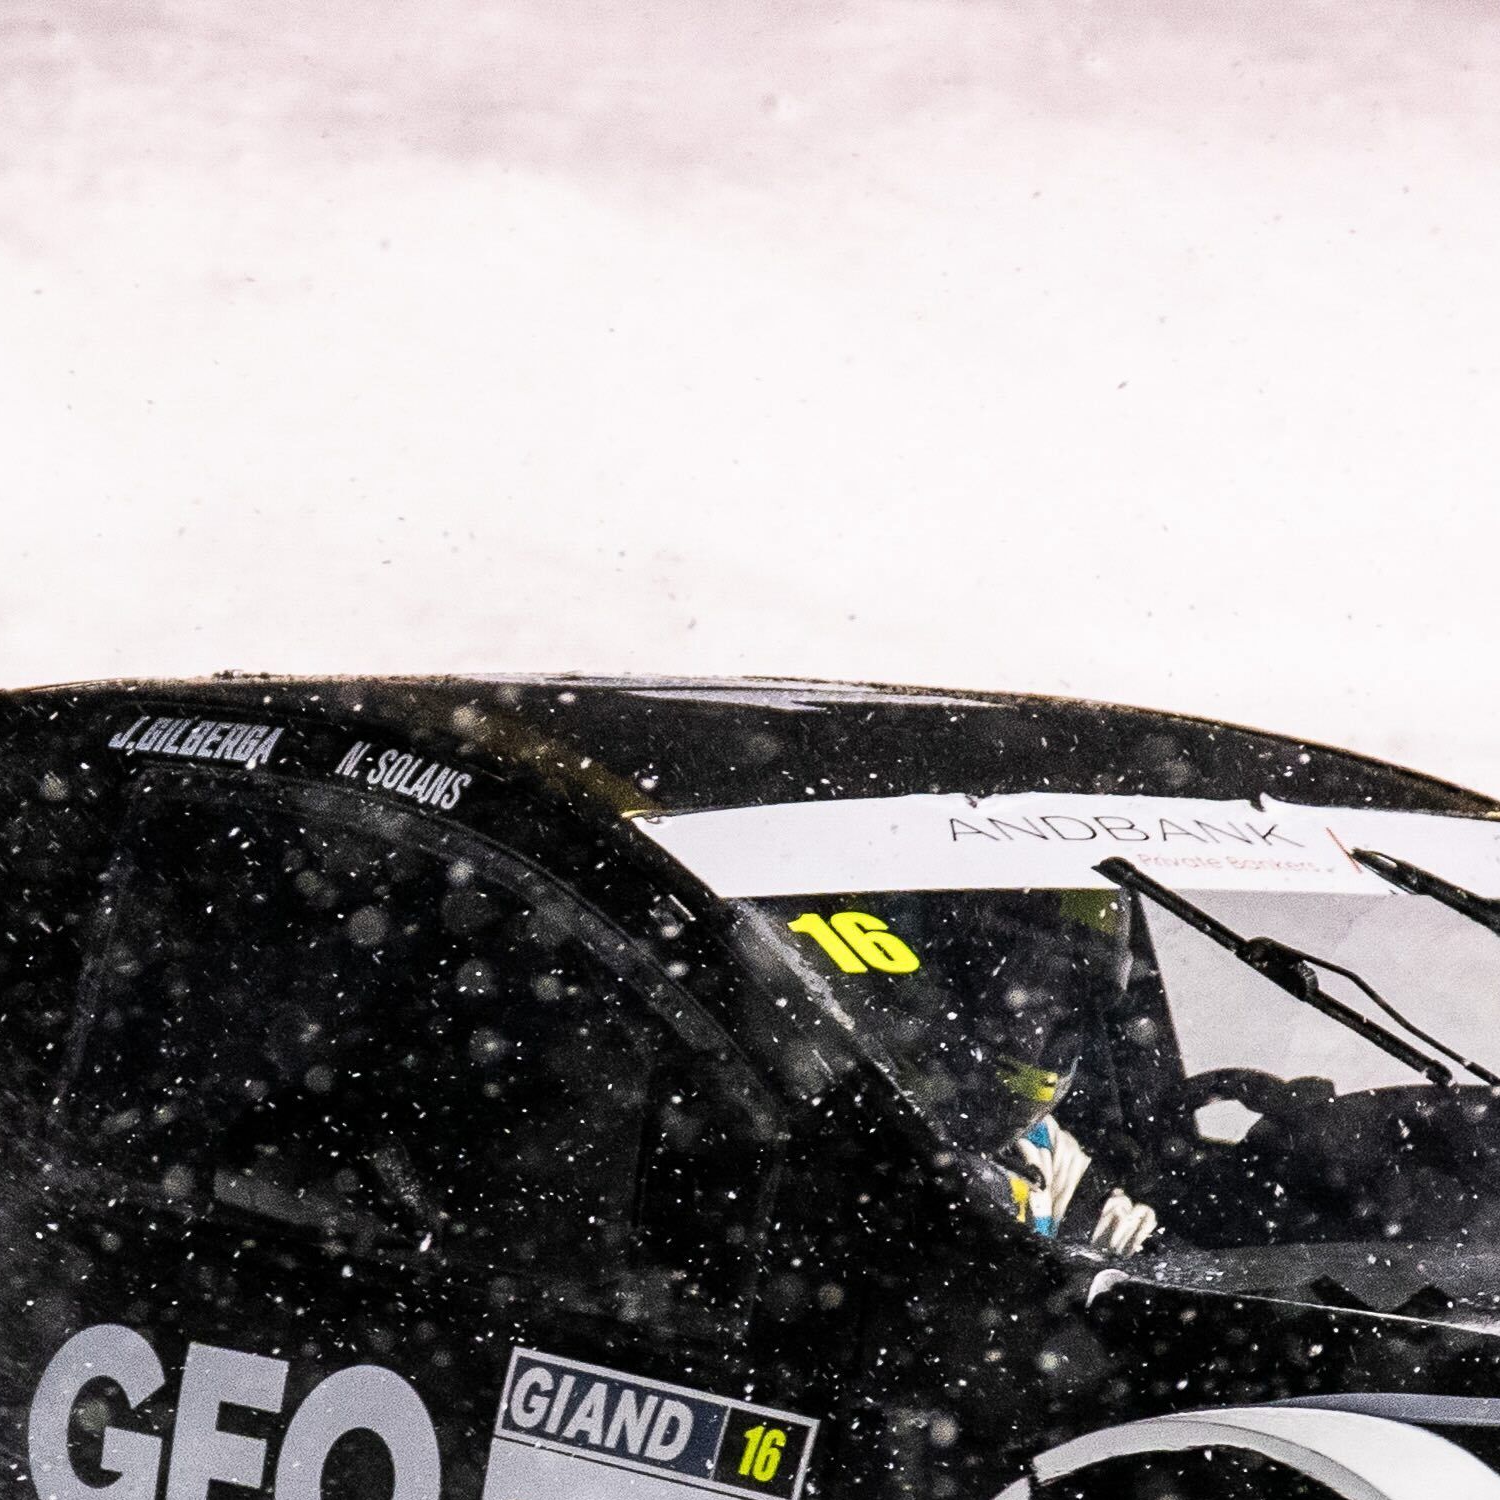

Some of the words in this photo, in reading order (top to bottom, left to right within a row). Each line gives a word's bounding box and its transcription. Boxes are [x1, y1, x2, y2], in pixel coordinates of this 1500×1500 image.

[369, 748, 472, 810] SOLANS
[949, 815, 1305, 848] ANDBANK
[1137, 853, 1221, 870] Private
[789, 911, 920, 975] 16
[510, 1367, 694, 1462] GIAND
[737, 1425, 787, 1483] 16
